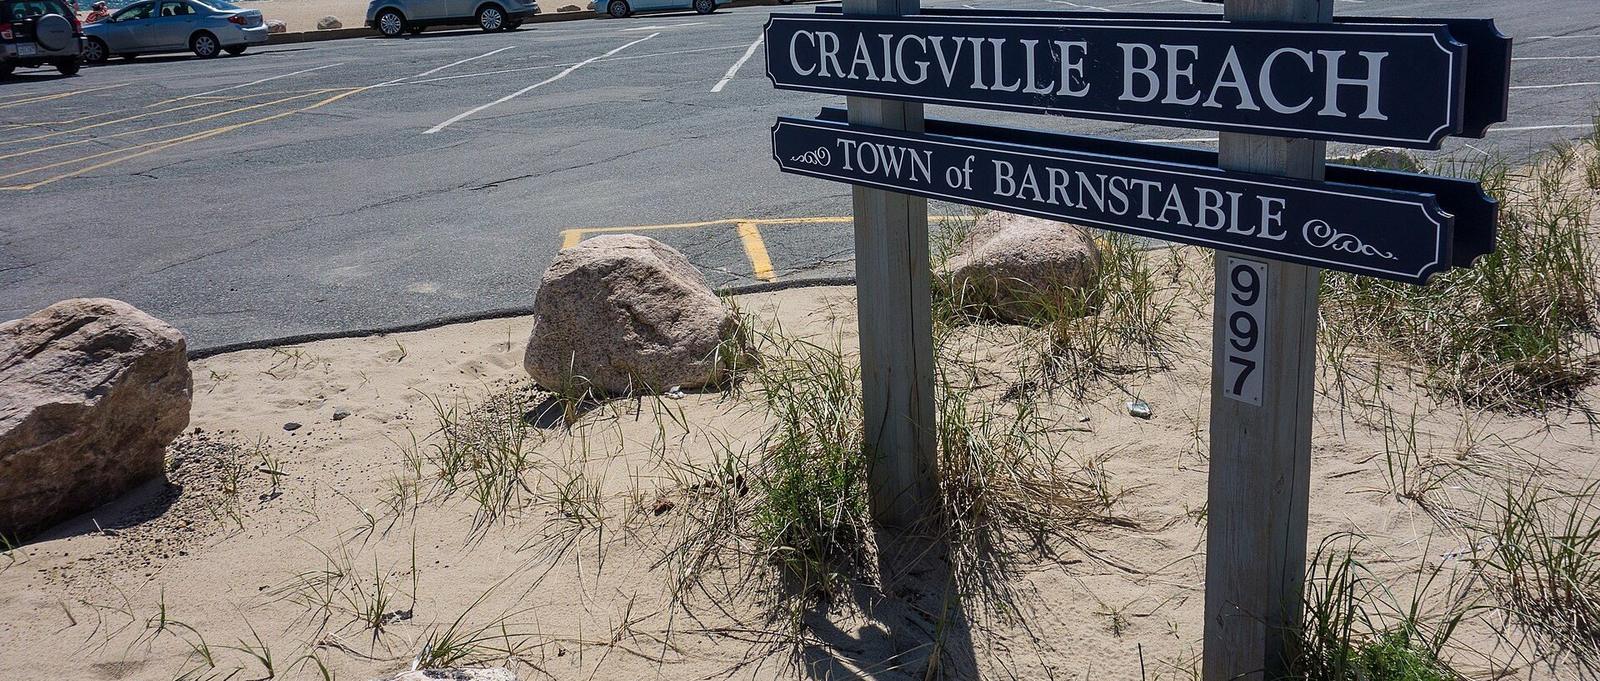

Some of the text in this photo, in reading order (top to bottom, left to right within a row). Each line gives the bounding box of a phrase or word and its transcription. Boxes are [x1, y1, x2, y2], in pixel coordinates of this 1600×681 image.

[789, 30, 1389, 121] CRAIGVILLE BEACH
[836, 138, 1287, 241] TOWN of BARNSTABLE
[1229, 264, 1260, 396] 997
